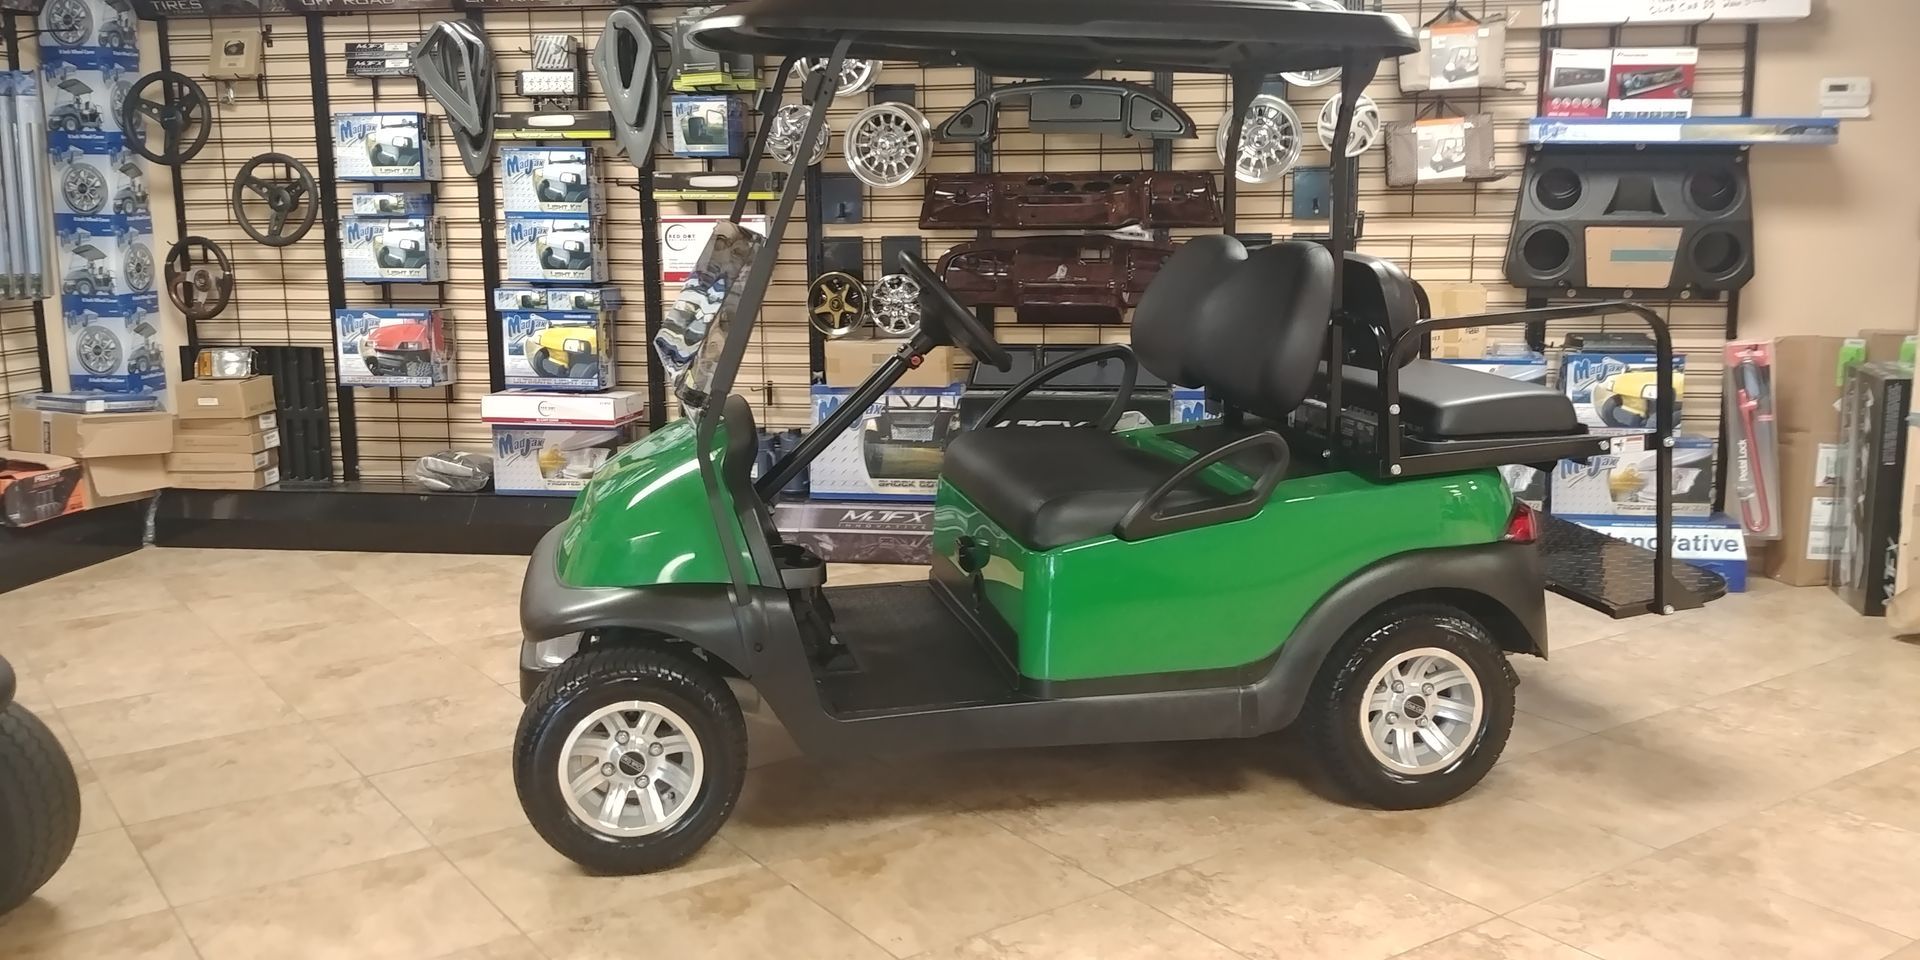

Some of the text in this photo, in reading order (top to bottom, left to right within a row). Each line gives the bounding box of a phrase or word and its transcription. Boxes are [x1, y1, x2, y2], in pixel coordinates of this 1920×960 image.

[153, 0, 203, 11] TIRES
[506, 155, 544, 177] MadJax
[347, 222, 385, 244] MadJax
[510, 223, 549, 245] MadJax
[340, 313, 381, 338] MadJax
[507, 314, 549, 338] MadJax
[1573, 357, 1625, 384] MadJax
[498, 433, 545, 459] MadJax
